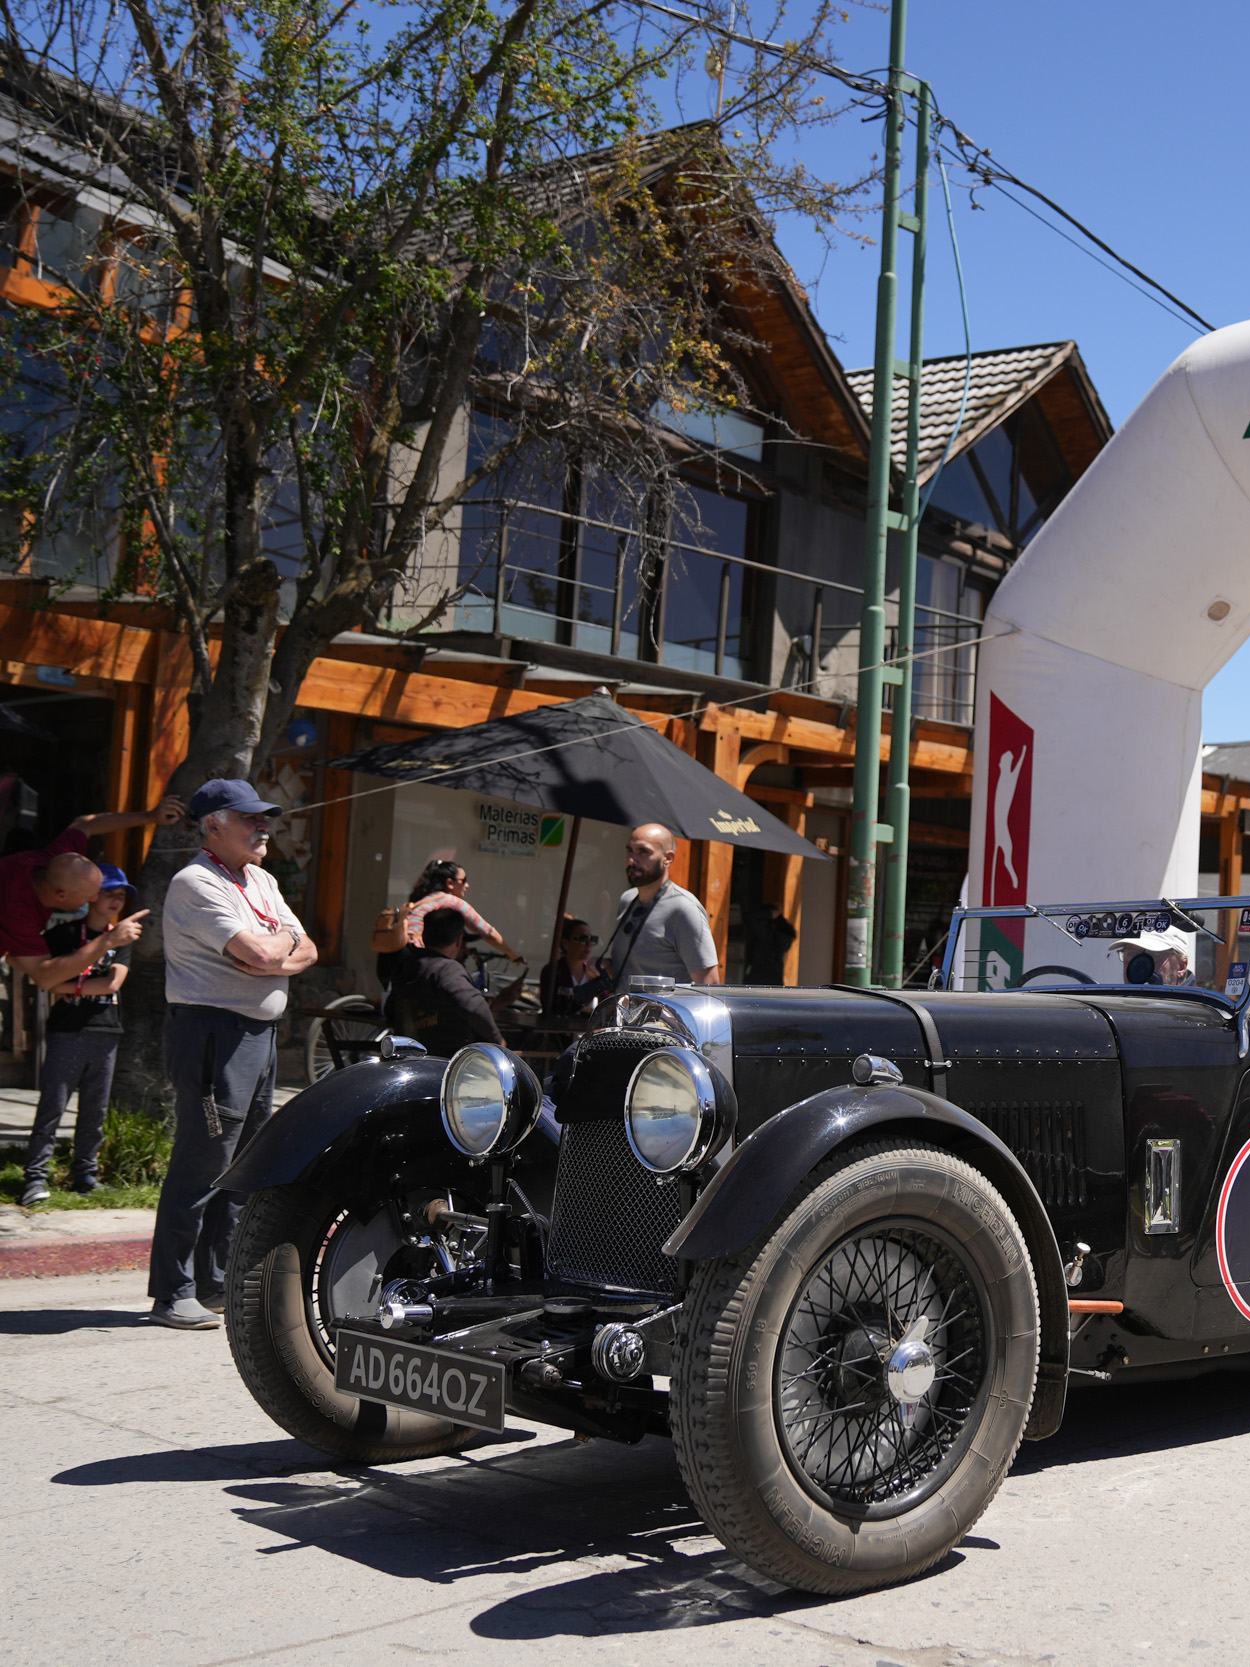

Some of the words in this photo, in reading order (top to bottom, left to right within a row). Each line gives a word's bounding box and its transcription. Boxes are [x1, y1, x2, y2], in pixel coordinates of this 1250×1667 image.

[480, 804, 538, 826] Materias
[487, 824, 536, 845] Primas
[1122, 918, 1128, 927] 6
[951, 1180, 1020, 1264] MICHELIN
[279, 1340, 345, 1423] MICHELIN
[350, 1343, 488, 1418] AD664QZ
[763, 1486, 847, 1567] MICHELIN
